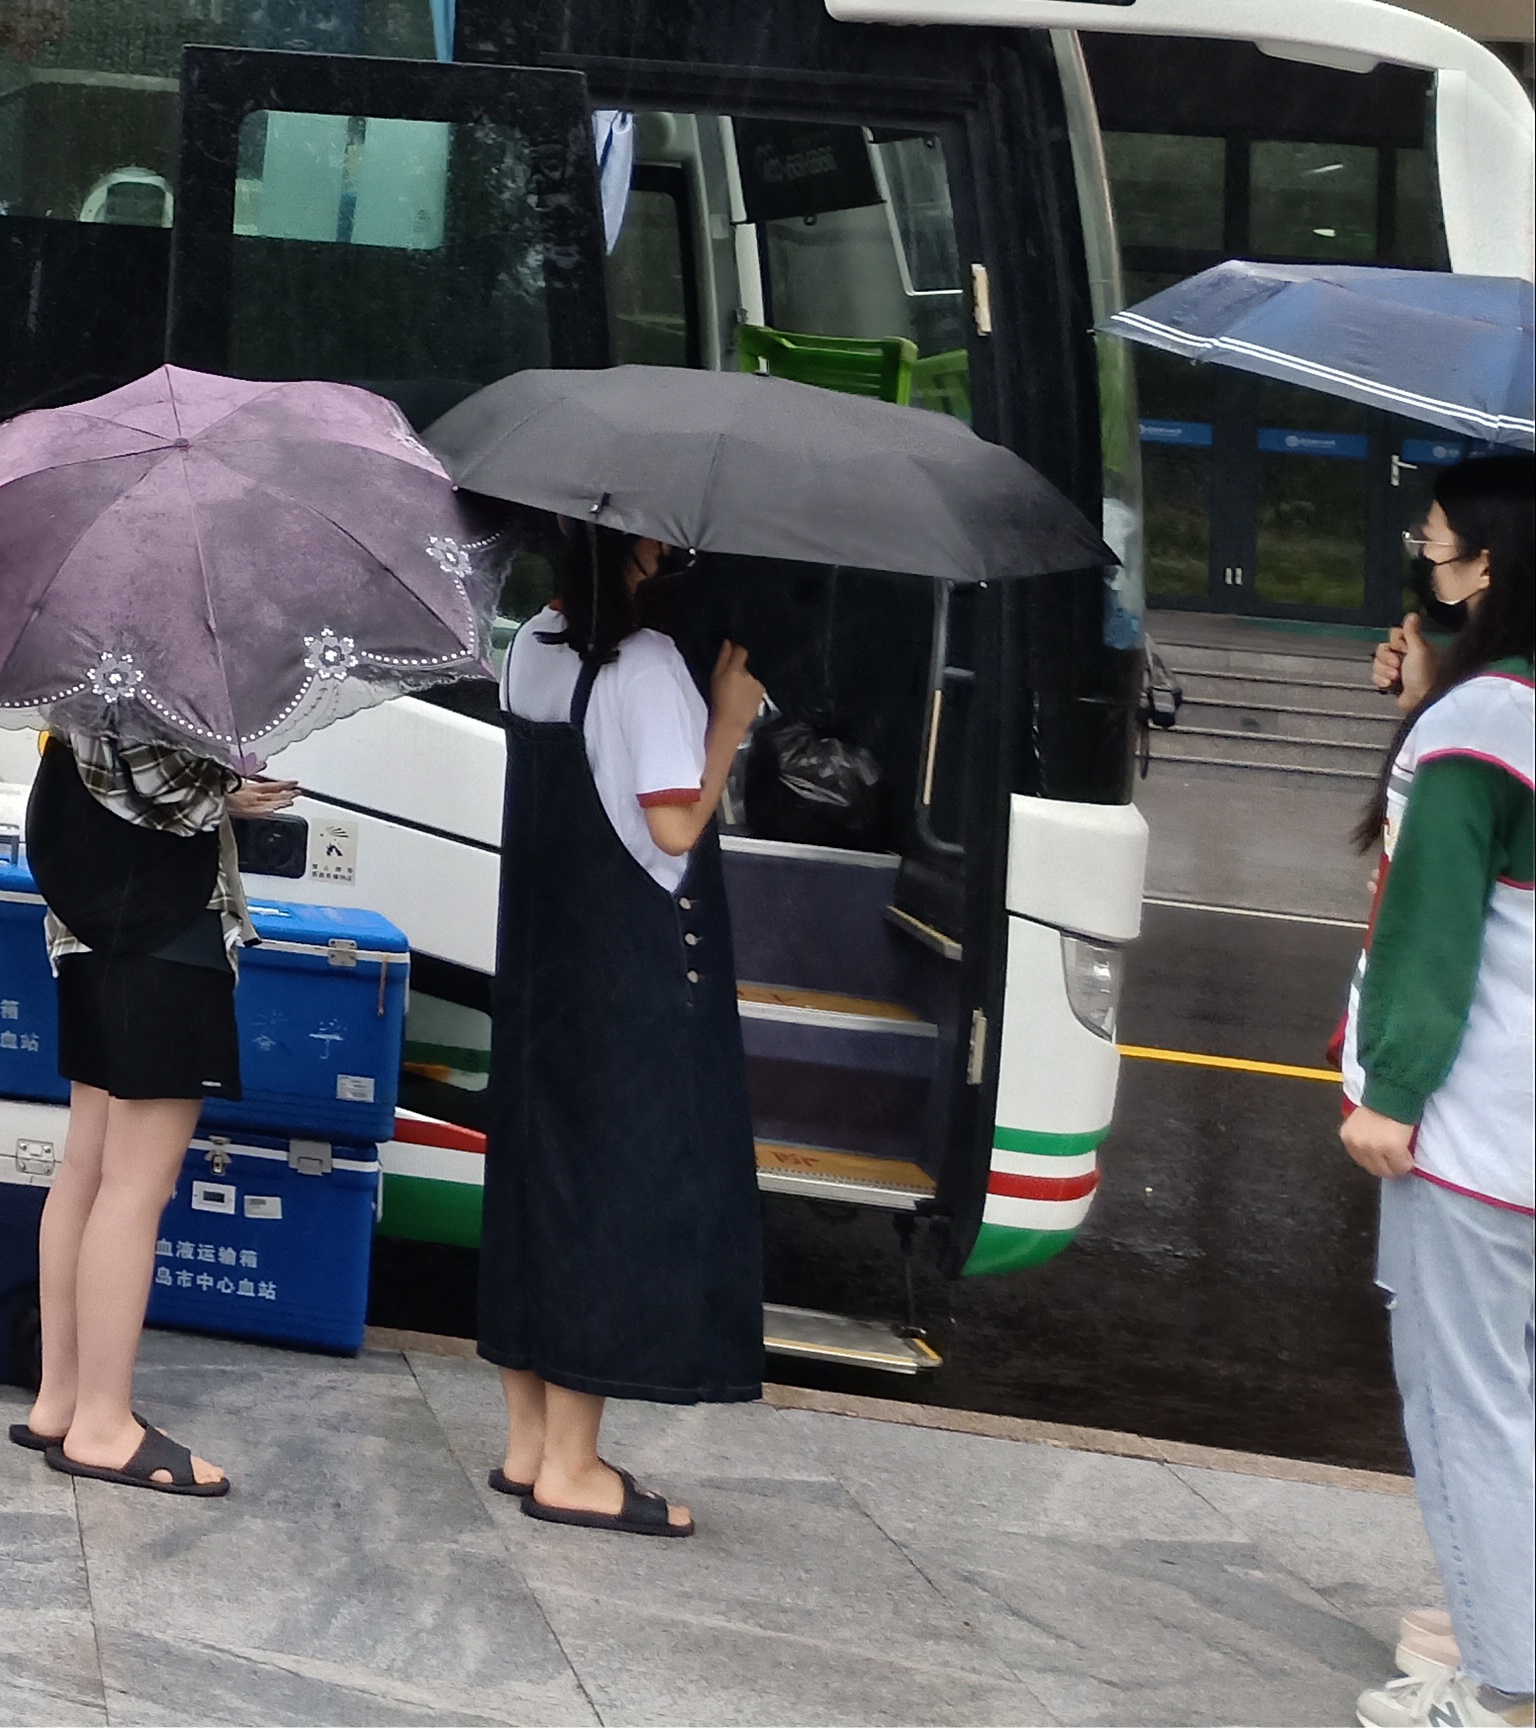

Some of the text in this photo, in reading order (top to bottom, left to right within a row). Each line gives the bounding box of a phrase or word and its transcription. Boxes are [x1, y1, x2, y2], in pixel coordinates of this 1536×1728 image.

[155, 1238, 259, 1268] 血液运输箱
[155, 1267, 277, 1300] 岛市中心血站
